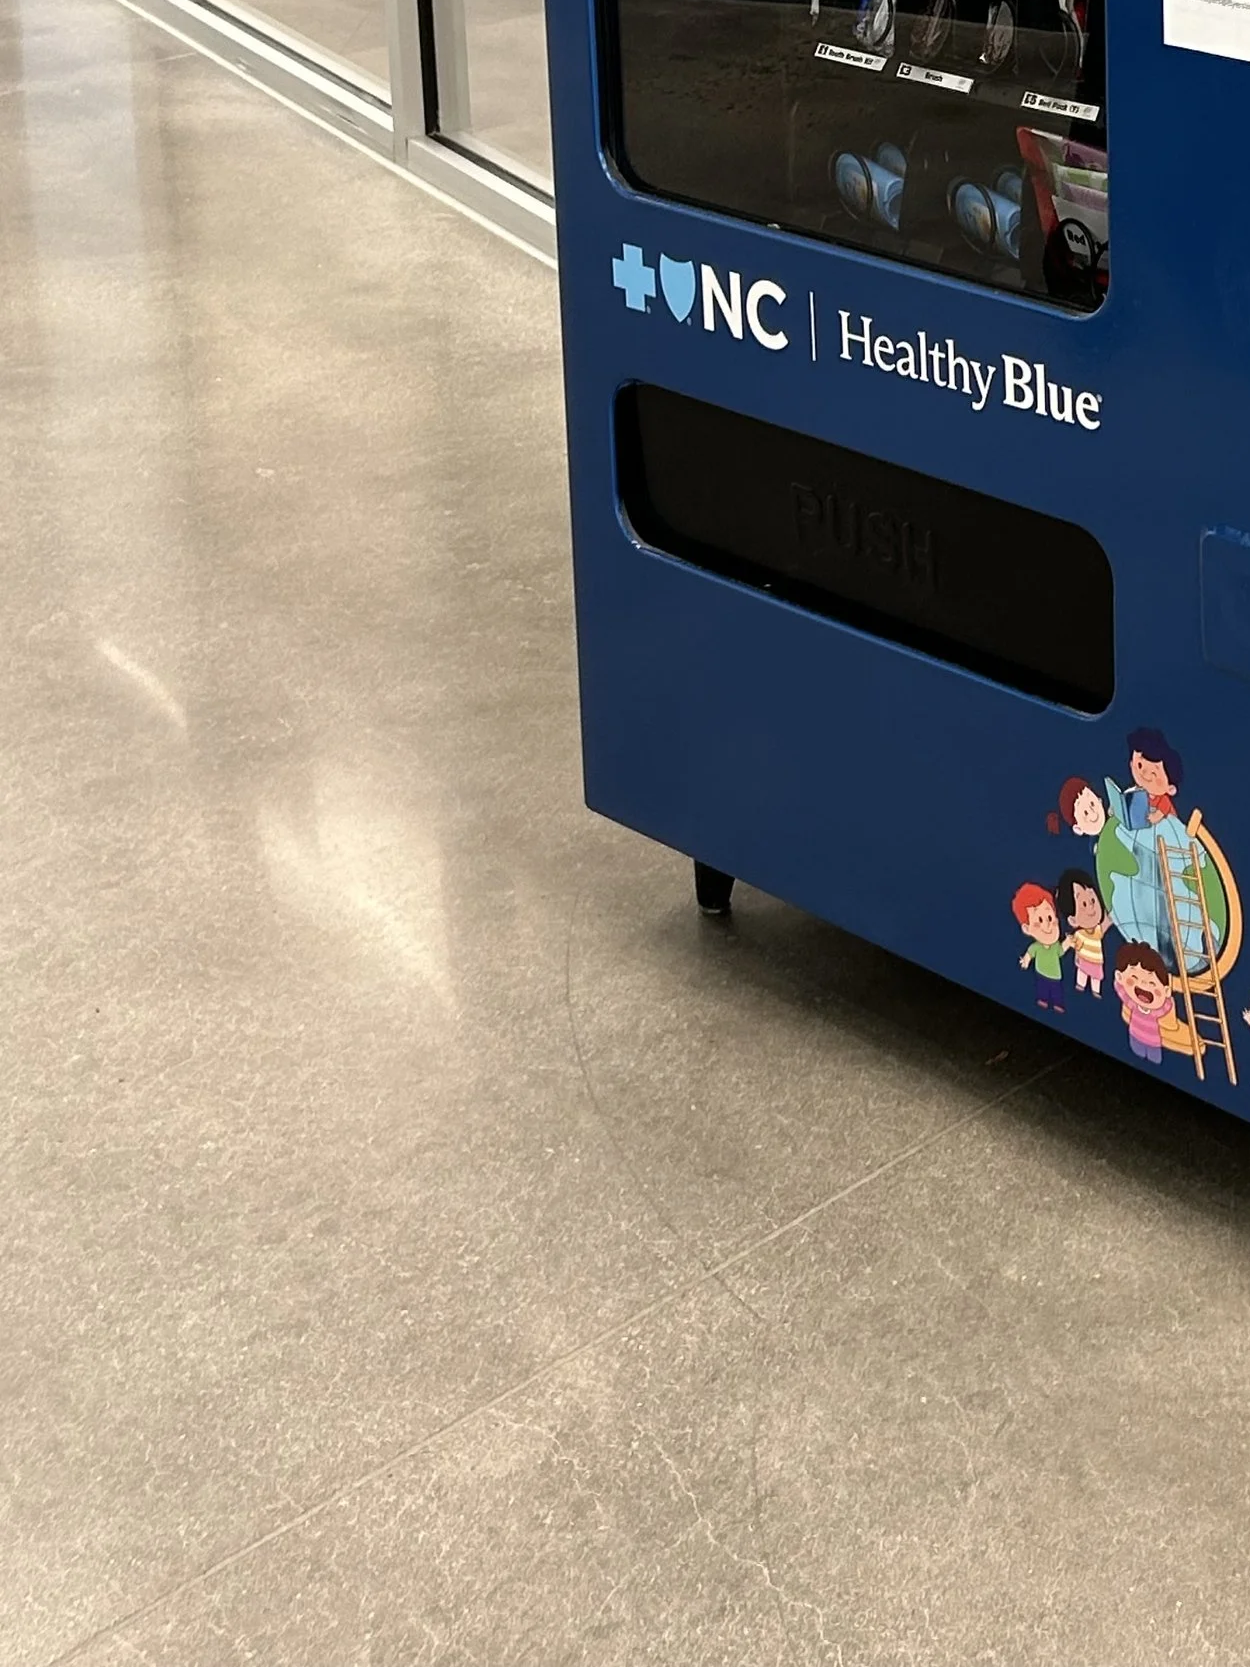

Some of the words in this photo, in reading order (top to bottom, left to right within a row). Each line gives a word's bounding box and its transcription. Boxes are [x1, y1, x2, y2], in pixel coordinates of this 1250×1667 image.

[925, 72, 943, 82] Brush
[1067, 228, 1086, 246] Red
[701, 263, 789, 351] NC
[838, 310, 996, 411] Healthy
[1001, 354, 1101, 430] Blue
